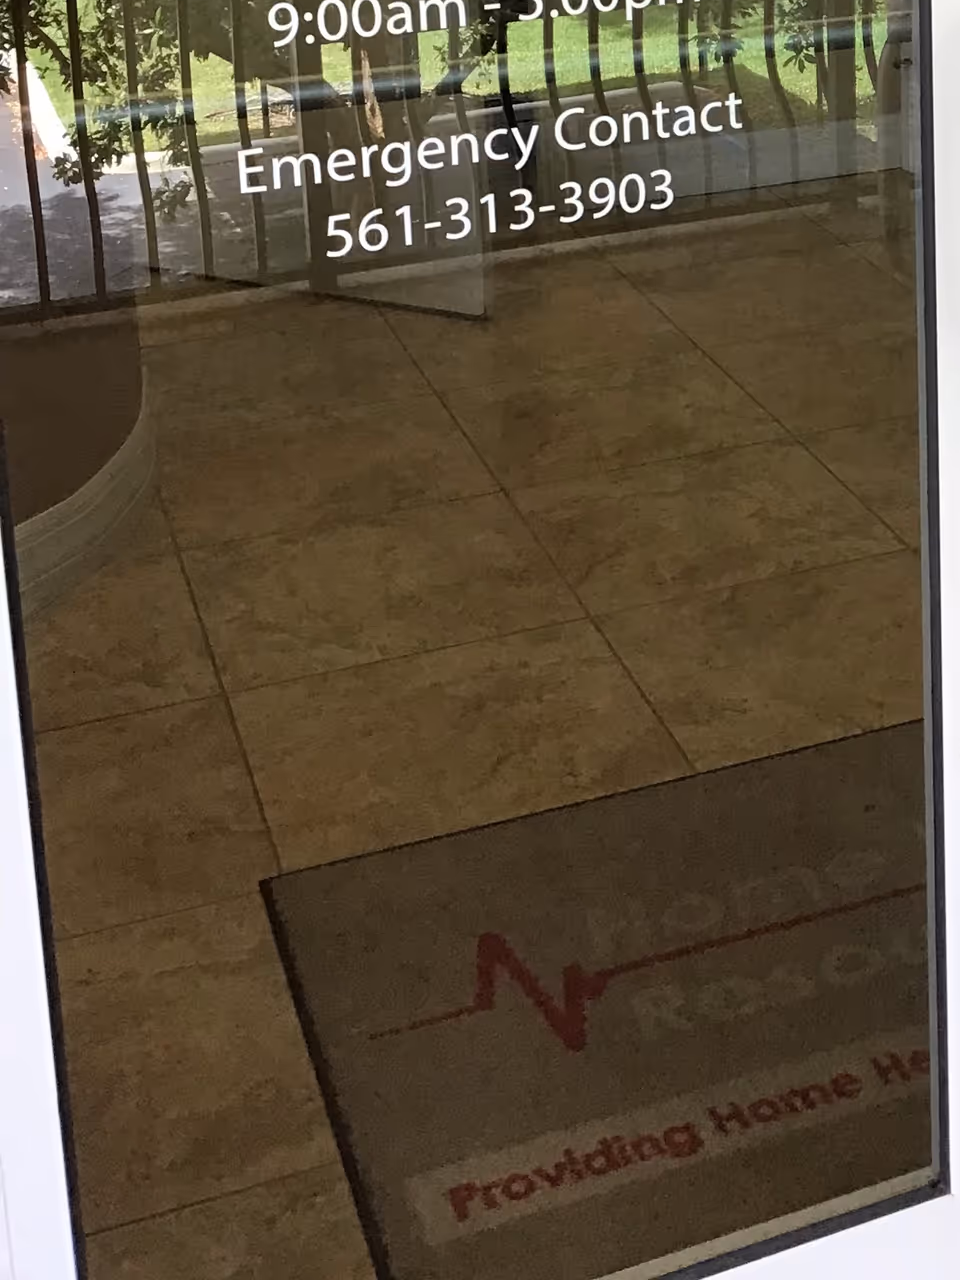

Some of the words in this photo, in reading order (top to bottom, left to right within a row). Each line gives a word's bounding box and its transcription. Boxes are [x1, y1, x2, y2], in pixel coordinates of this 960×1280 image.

[483, 2, 503, 13] -
[237, 123, 540, 195] Emergency
[554, 92, 744, 150] Contact
[325, 169, 675, 258] 561-313-3903
[446, 1119, 706, 1222] Providing
[707, 1070, 863, 1136] Home
